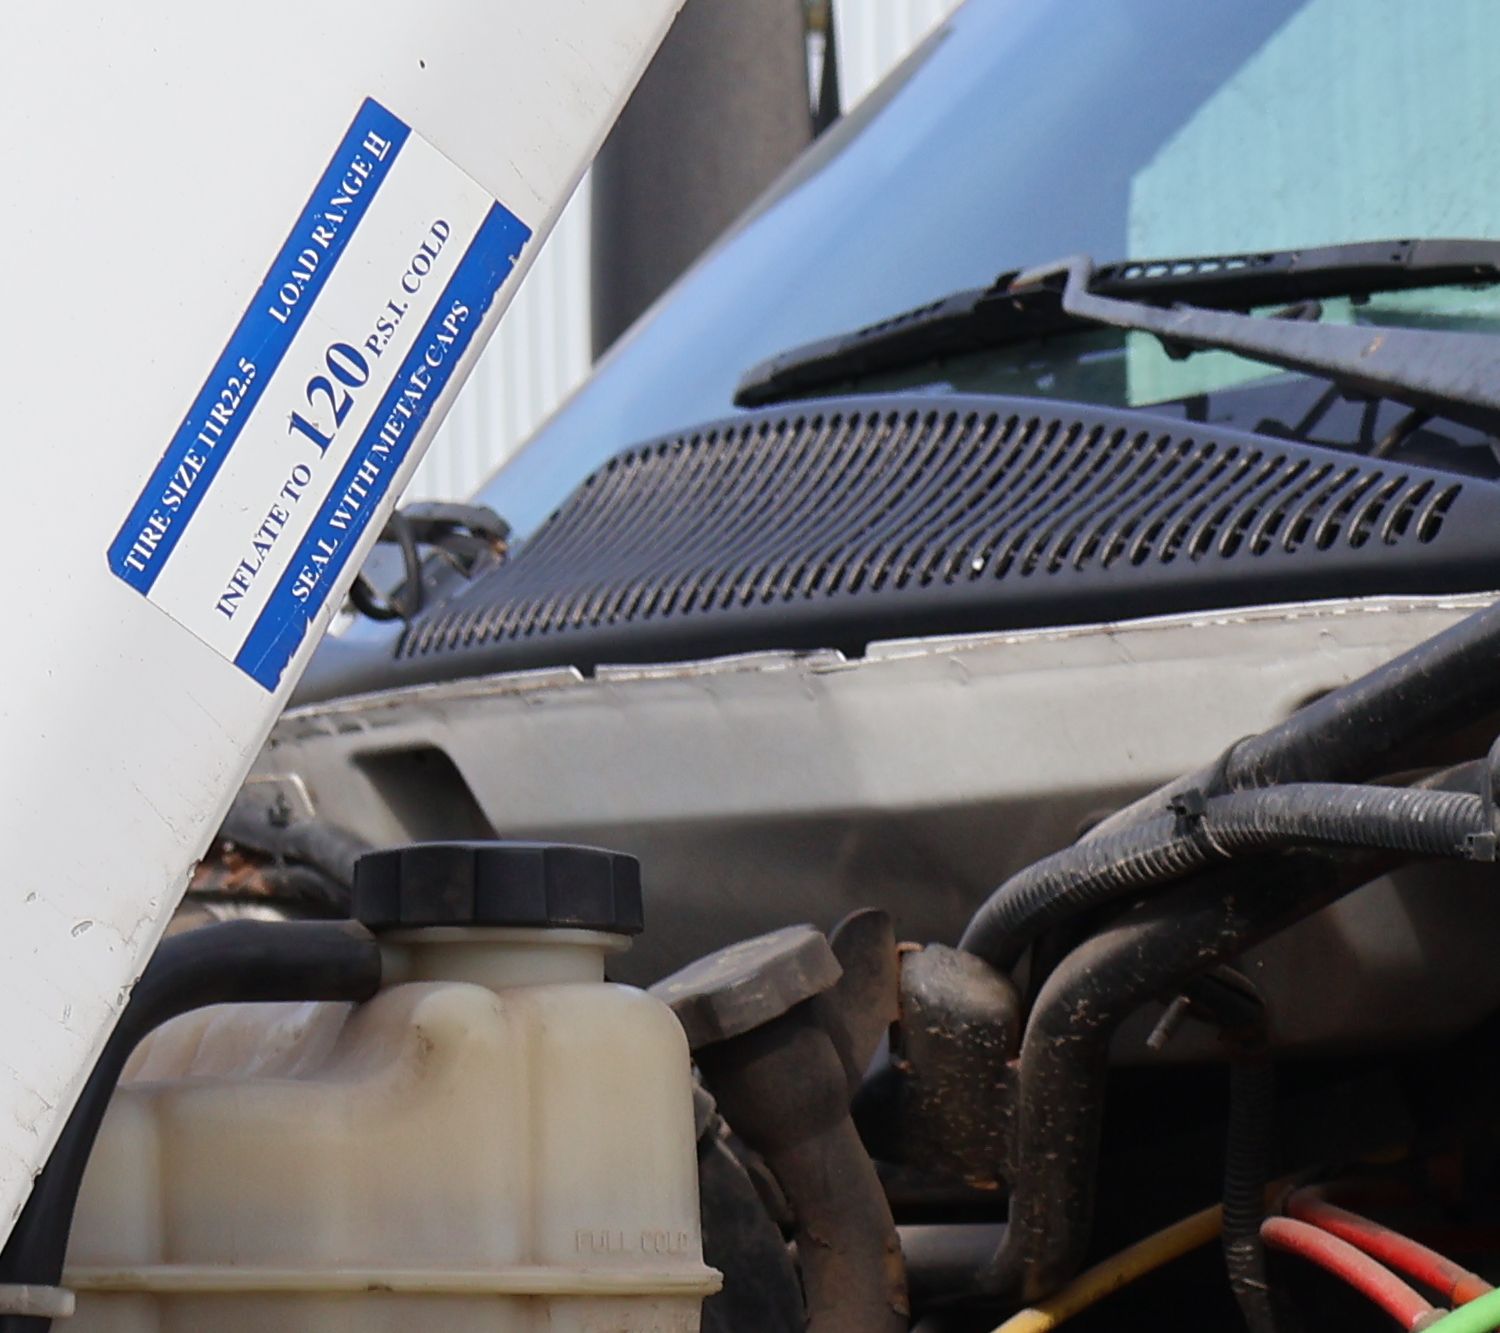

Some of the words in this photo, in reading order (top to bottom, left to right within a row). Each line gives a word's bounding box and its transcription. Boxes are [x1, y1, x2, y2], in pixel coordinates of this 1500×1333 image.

[402, 220, 450, 294] COLD
[123, 509, 172, 572] TIRE
[162, 448, 206, 512] SIZE
[198, 357, 256, 449] 11R22.5
[268, 249, 319, 324] LOAD
[311, 154, 373, 249] RANGE
[362, 131, 392, 162] H
[365, 301, 408, 357] P.S.I.
[288, 342, 370, 460] 120
[280, 464, 311, 502] TO
[292, 539, 339, 603] SEAL
[329, 458, 380, 529] WITH
[373, 366, 430, 461] METAL
[425, 300, 469, 367] CAPS
[216, 504, 290, 619] INFLATE
[575, 1229, 631, 1253] FULL
[640, 1229, 688, 1254] COLD
